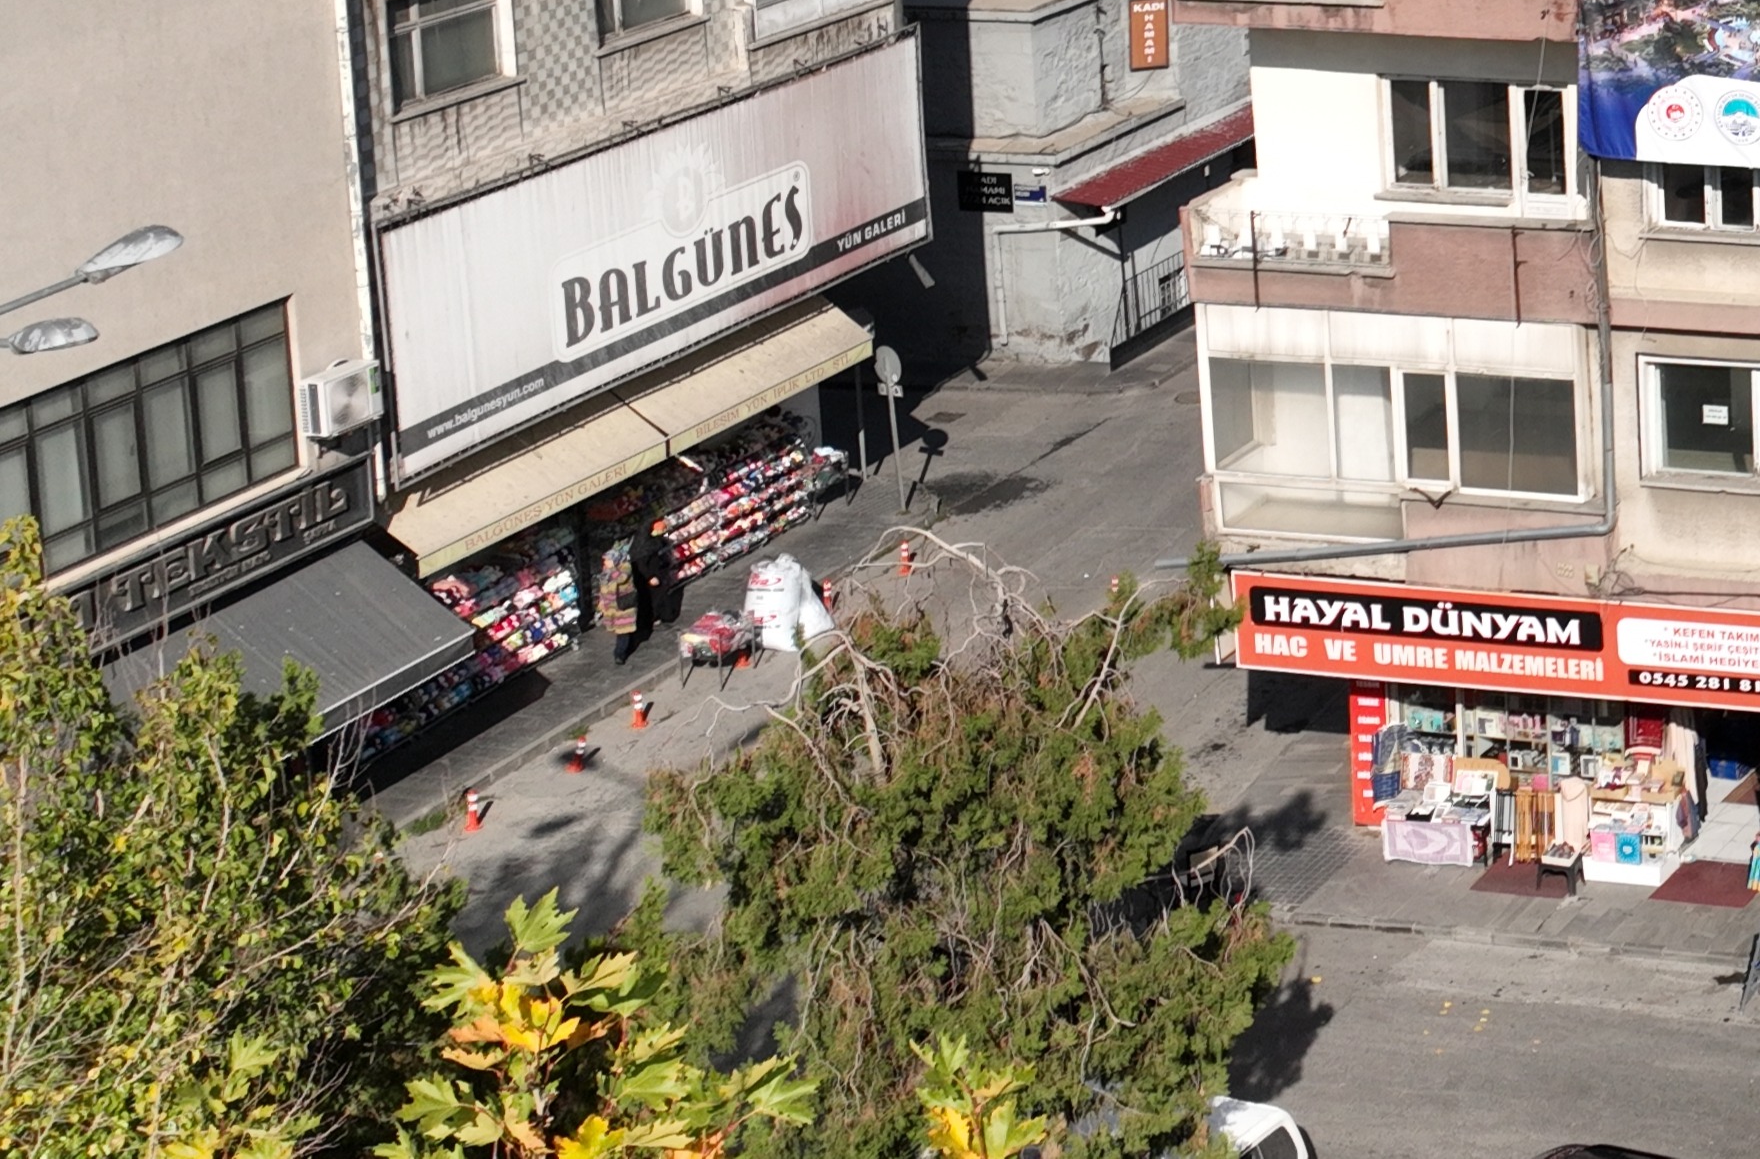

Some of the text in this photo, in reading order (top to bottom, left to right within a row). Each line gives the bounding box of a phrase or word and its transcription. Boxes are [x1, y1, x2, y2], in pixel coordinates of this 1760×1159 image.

[1132, 1, 1165, 13] KADI
[1144, 14, 1155, 63] HAMAMI
[561, 184, 804, 349] BALGÜNEŞ
[426, 208, 907, 439] www.balgunesyun.com YÜN GALERİ
[544, 488, 574, 515] YÜN
[112, 480, 349, 612] TEKSTİL
[1263, 594, 1582, 646] HAYAL DÜNYAM
[1673, 627, 1715, 639] KEFEN
[1253, 631, 1605, 682] HAC VE UMRE MALZEMELERİ
[1638, 671, 1689, 688] 0545
[1695, 675, 1730, 691] 281
[1738, 679, 1760, 693] 81
